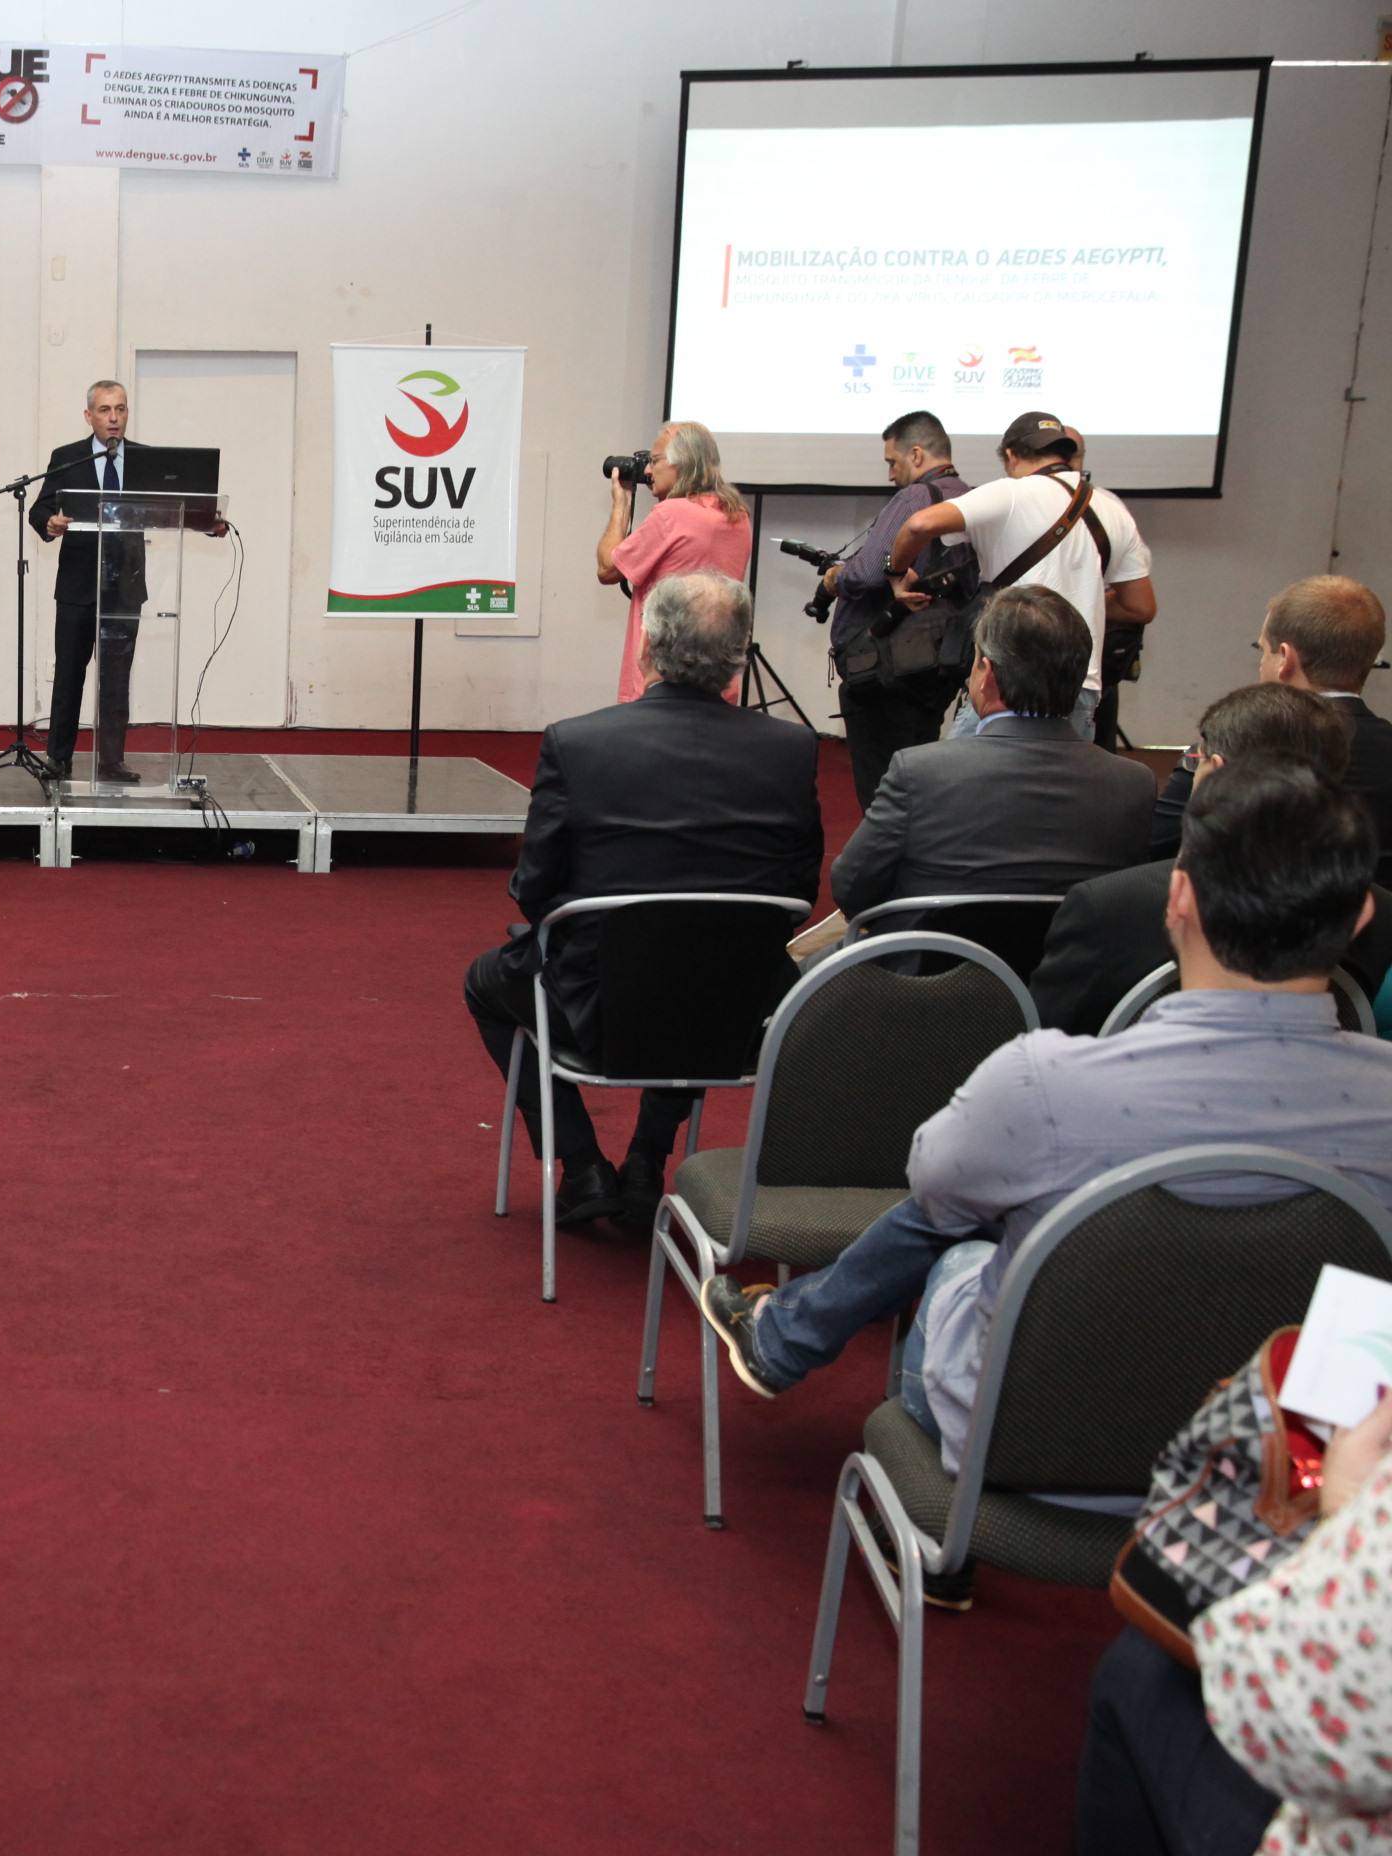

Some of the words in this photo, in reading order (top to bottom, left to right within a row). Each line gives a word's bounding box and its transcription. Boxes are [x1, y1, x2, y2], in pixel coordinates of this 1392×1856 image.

[103, 70, 111, 79] O
[112, 70, 142, 81] AEDES
[143, 73, 182, 84] AEGYPTI
[184, 75, 237, 88] TRANSMITE
[238, 79, 251, 88] AS
[252, 80, 297, 93] DOENÇAS
[104, 83, 146, 95] DENGUE,
[148, 85, 169, 95] ZIKA
[171, 87, 177, 96] E
[179, 87, 208, 98] FEBRE
[209, 90, 222, 99] DE
[102, 95, 148, 107] ELIMINAR
[149, 98, 162, 108] OS
[164, 99, 226, 113] CRIADOUROS
[228, 104, 242, 113] DO
[244, 105, 295, 117] MOSQUITO
[124, 109, 154, 120] AINDA
[156, 110, 161, 121] É
[163, 112, 170, 121] A
[172, 113, 212, 124] MELHOR
[213, 116, 272, 128] ESTRATÉGIA.
[95, 148, 217, 163] www.dengue.sc.gov.br
[737, 246, 878, 272] MOBILIZAÇÃO
[884, 249, 969, 267] CONTRA
[975, 248, 990, 266] O
[995, 248, 1067, 266] AEDES
[1071, 246, 1169, 268] AEGYPTI,
[735, 273, 808, 286] MOSQUITO
[913, 273, 932, 286] DA
[1001, 272, 1020, 285] DA
[1072, 272, 1092, 284] DE
[892, 365, 937, 380] DIVE
[953, 370, 985, 383] SUV
[844, 382, 872, 394] SUS
[374, 465, 477, 509] SUV
[373, 515, 460, 530] Superintendência
[463, 516, 475, 529] de
[374, 530, 422, 546] Vigilância
[425, 534, 440, 544] em
[443, 530, 474, 544] Saúde
